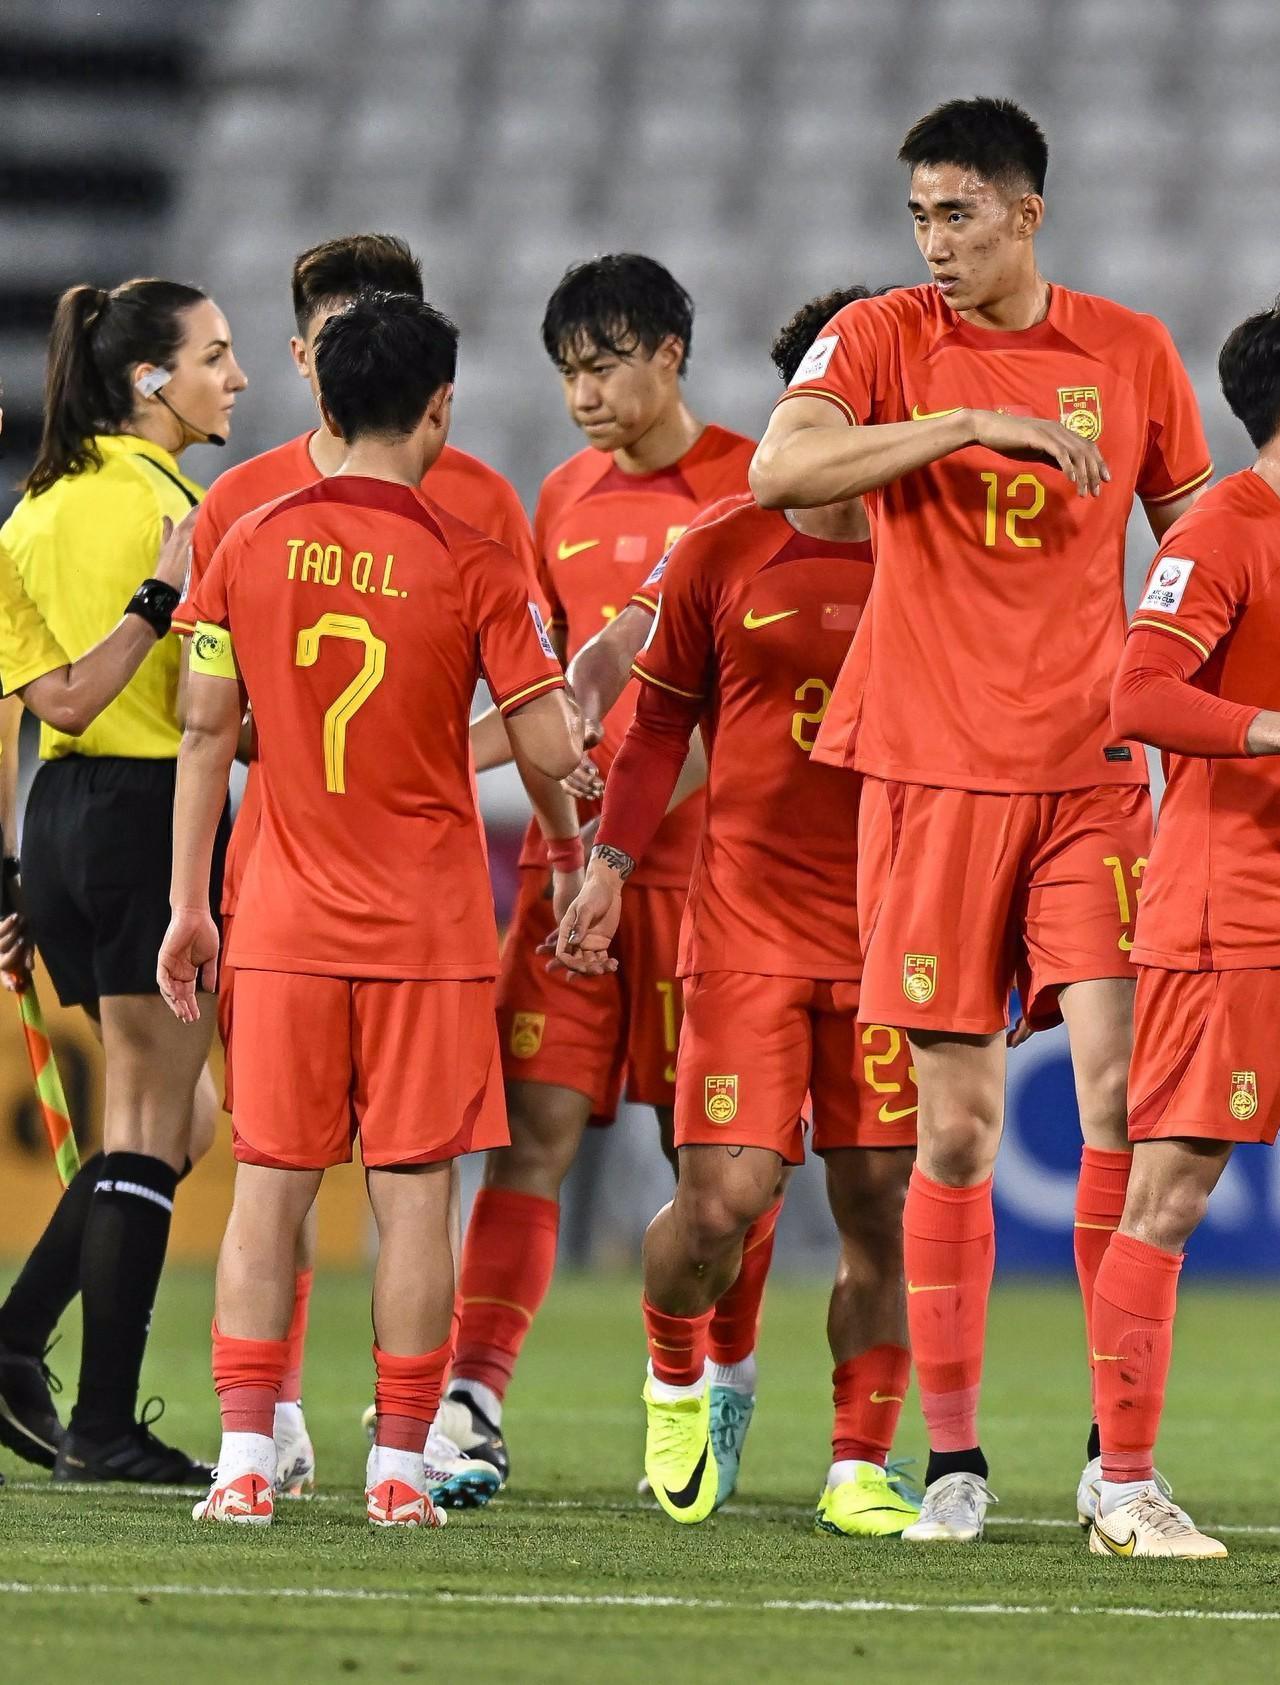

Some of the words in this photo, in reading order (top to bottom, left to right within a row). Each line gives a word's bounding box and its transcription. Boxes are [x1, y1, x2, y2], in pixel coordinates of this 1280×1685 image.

[1062, 391, 1096, 402] CFA
[980, 472, 1045, 548] 12
[287, 539, 342, 586] TAO
[351, 551, 408, 598] Q.L.
[295, 612, 387, 794] 7
[908, 957, 934, 968] CFA
[708, 1079, 734, 1088] CFA
